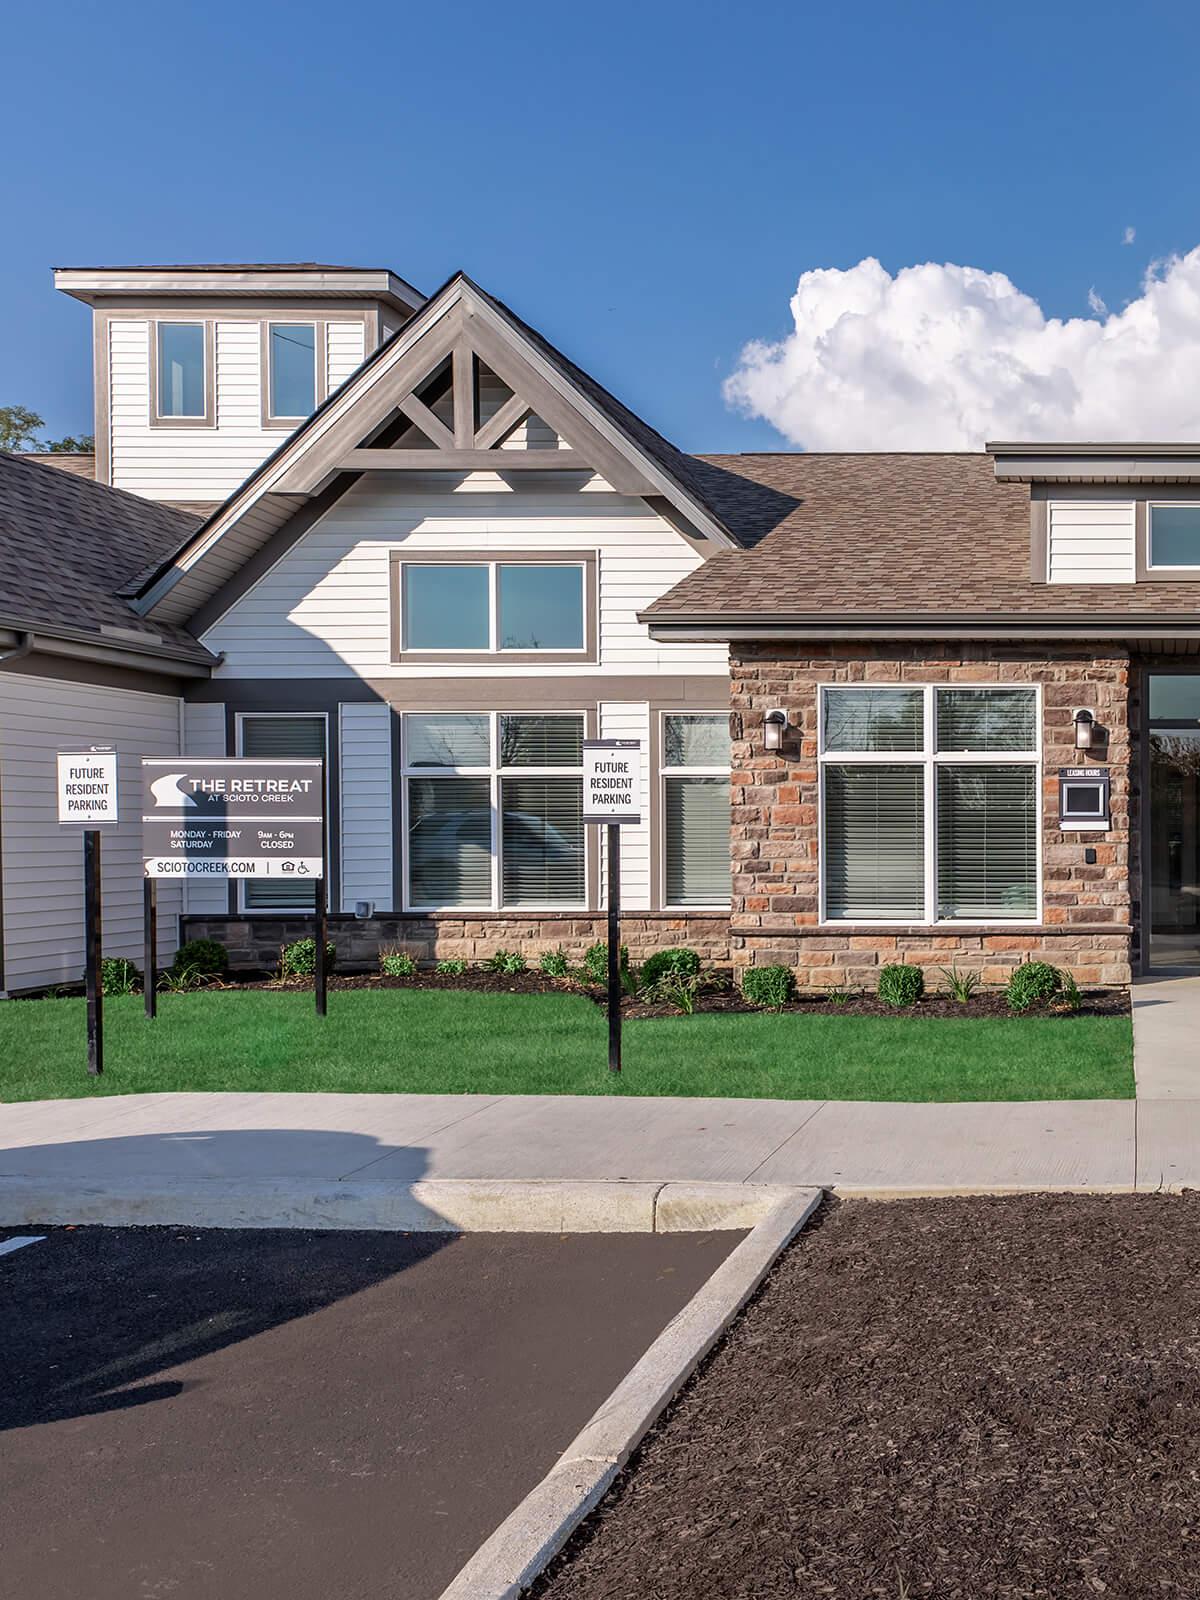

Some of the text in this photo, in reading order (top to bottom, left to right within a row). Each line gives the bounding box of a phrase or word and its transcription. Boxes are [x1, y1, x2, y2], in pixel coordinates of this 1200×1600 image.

[594, 762, 630, 773] FUTURE
[69, 768, 105, 779] FUTURE
[189, 779, 313, 792] THE RETREAT
[590, 777, 634, 789] RESIDENT
[65, 783, 109, 795] RESIDENT
[207, 794, 294, 802] AT SCIOTO CREEK
[592, 793, 632, 804] PARKING
[68, 799, 108, 811] PARKING
[170, 831, 206, 839] MONDAY
[212, 831, 242, 839] FRIDAY
[170, 840, 294, 849] SATURDAY CLOSED
[157, 862, 256, 873] SCIOTOCREEK.COM
